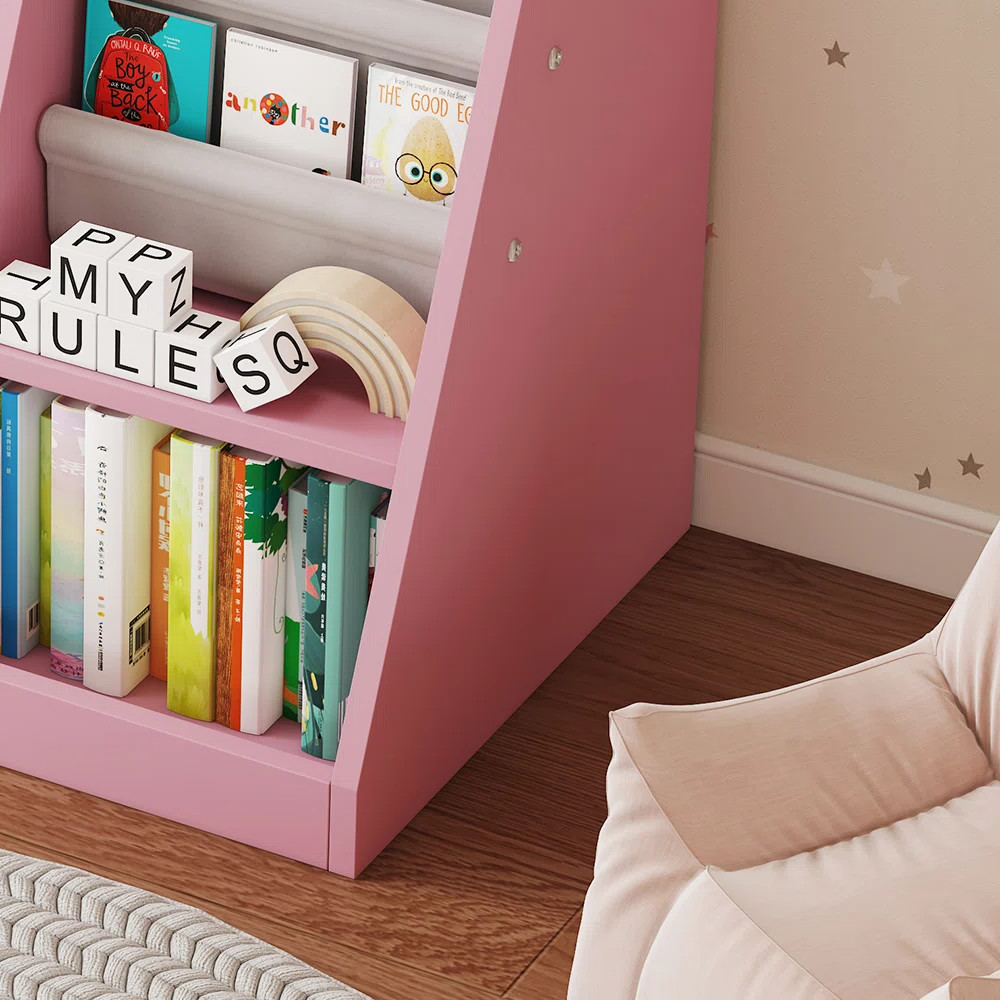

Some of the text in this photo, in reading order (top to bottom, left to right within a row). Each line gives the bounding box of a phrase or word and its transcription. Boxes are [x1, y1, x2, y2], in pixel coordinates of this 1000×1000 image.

[378, 83, 402, 107] THE
[411, 92, 449, 118] GOOD
[59, 255, 153, 316] MY
